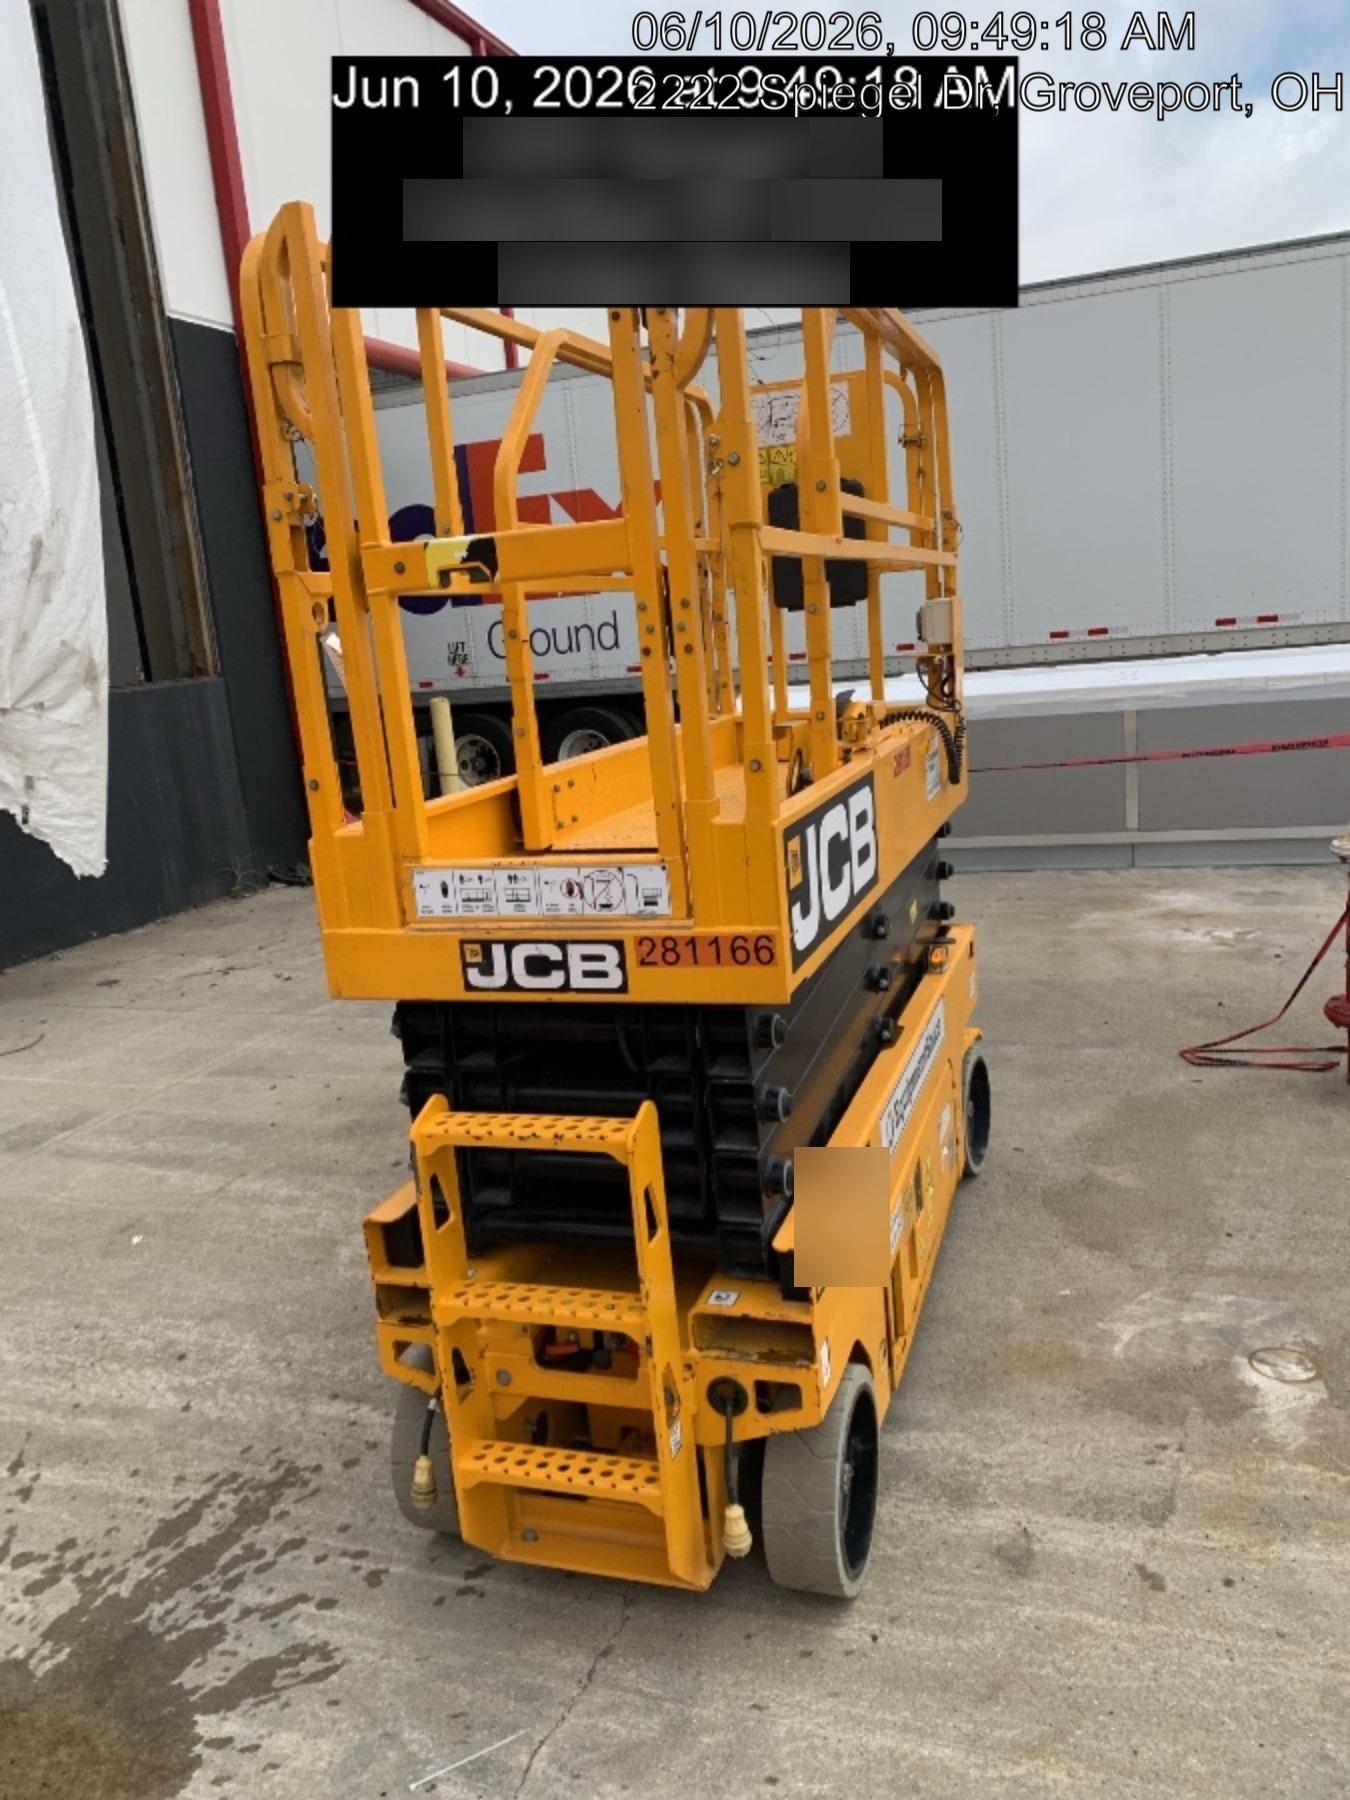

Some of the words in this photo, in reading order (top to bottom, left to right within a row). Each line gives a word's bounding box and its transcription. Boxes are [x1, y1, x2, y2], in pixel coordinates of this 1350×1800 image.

[487, 610, 621, 660] Gound
[791, 785, 877, 950] JCB
[466, 943, 624, 989] JCB
[638, 936, 776, 966] 281166
